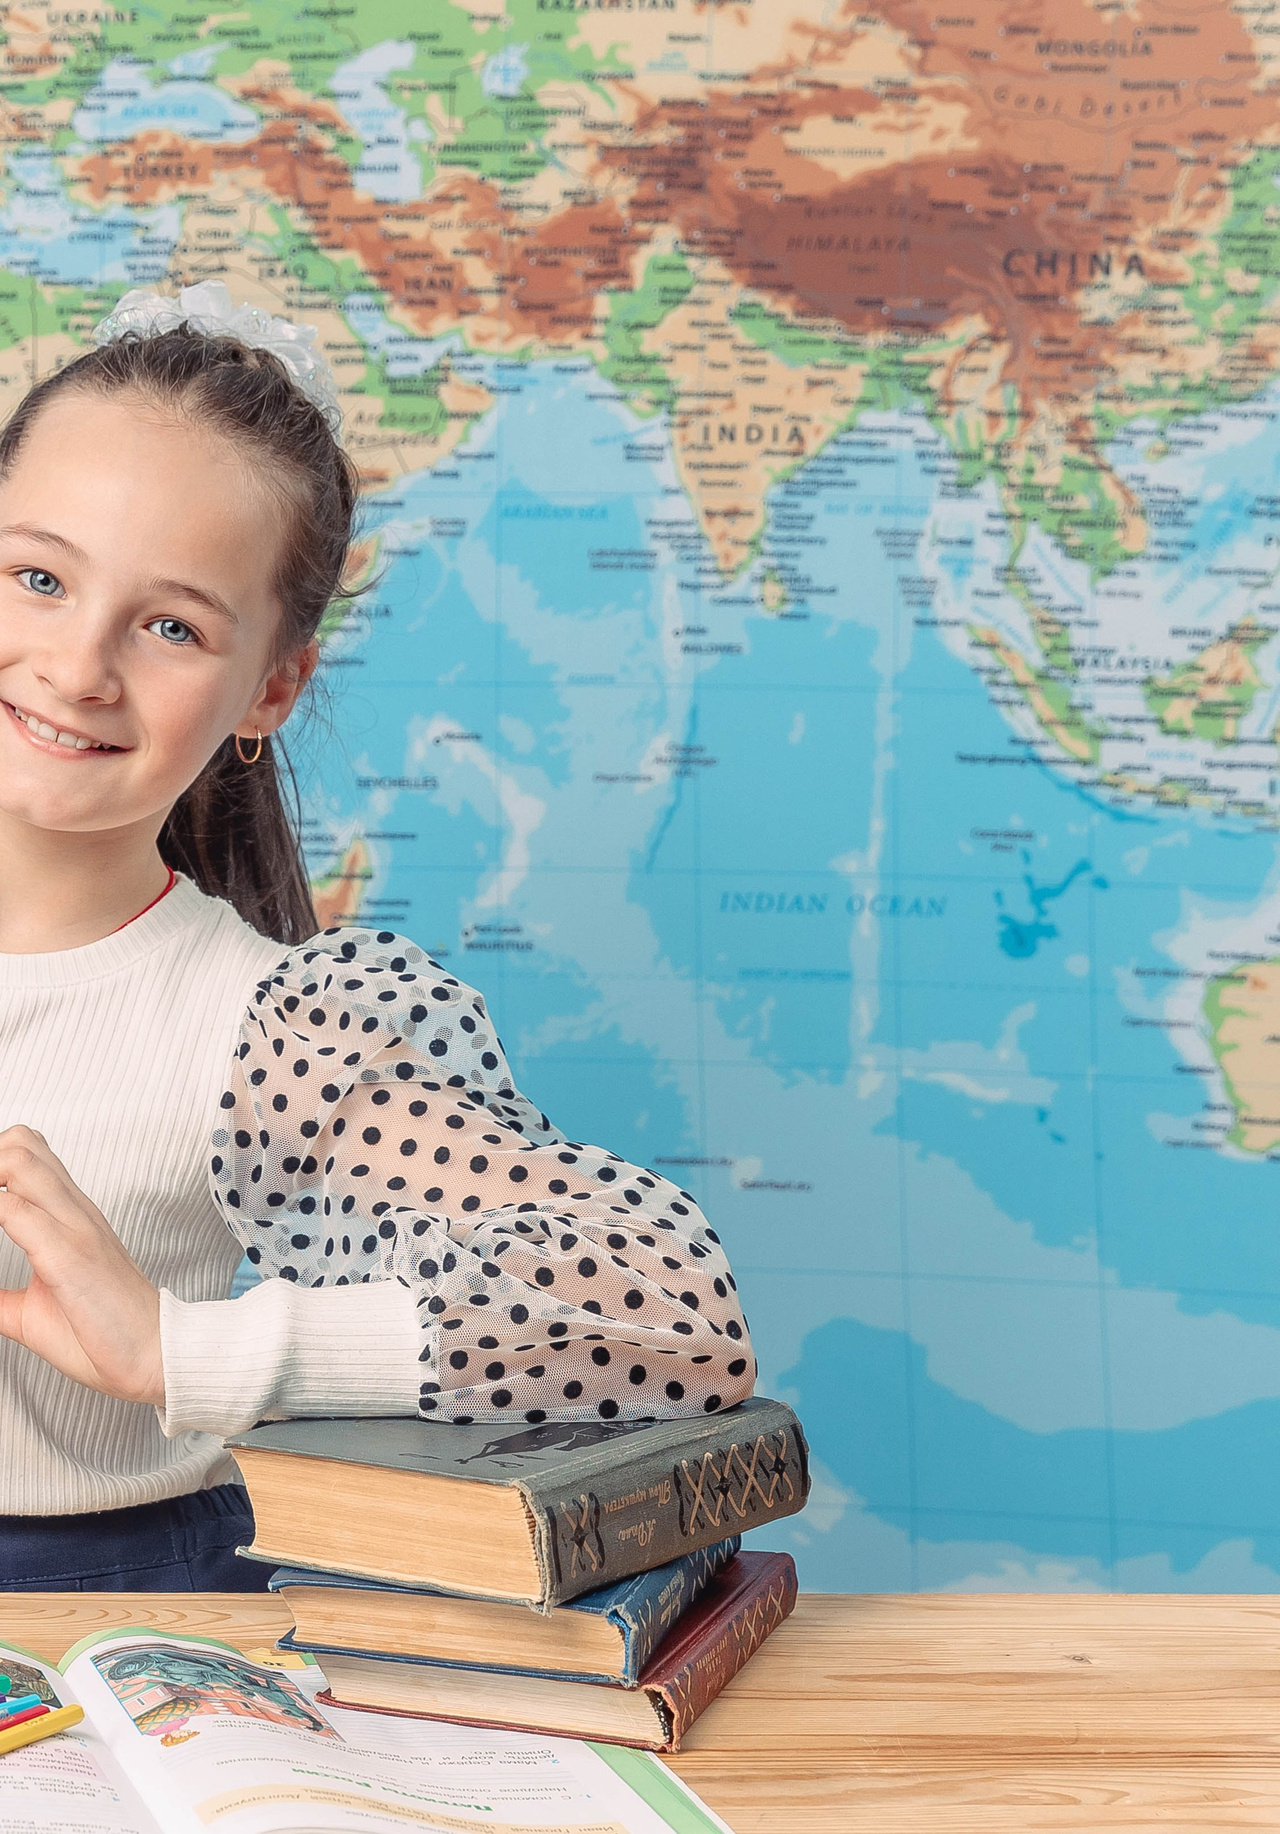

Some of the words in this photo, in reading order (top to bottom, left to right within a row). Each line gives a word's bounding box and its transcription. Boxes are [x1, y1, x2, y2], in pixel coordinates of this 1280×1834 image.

[1035, 41, 1152, 57] MONGOLIA
[122, 165, 199, 179] TURKEY
[1004, 249, 1146, 277] CHINA
[259, 266, 307, 280] IRAQ
[404, 276, 453, 293] IRAN
[703, 424, 804, 444] INDIA
[1071, 657, 1173, 671] MALAYSIA
[721, 892, 828, 914] INDIAN
[847, 893, 946, 917] OCEAN
